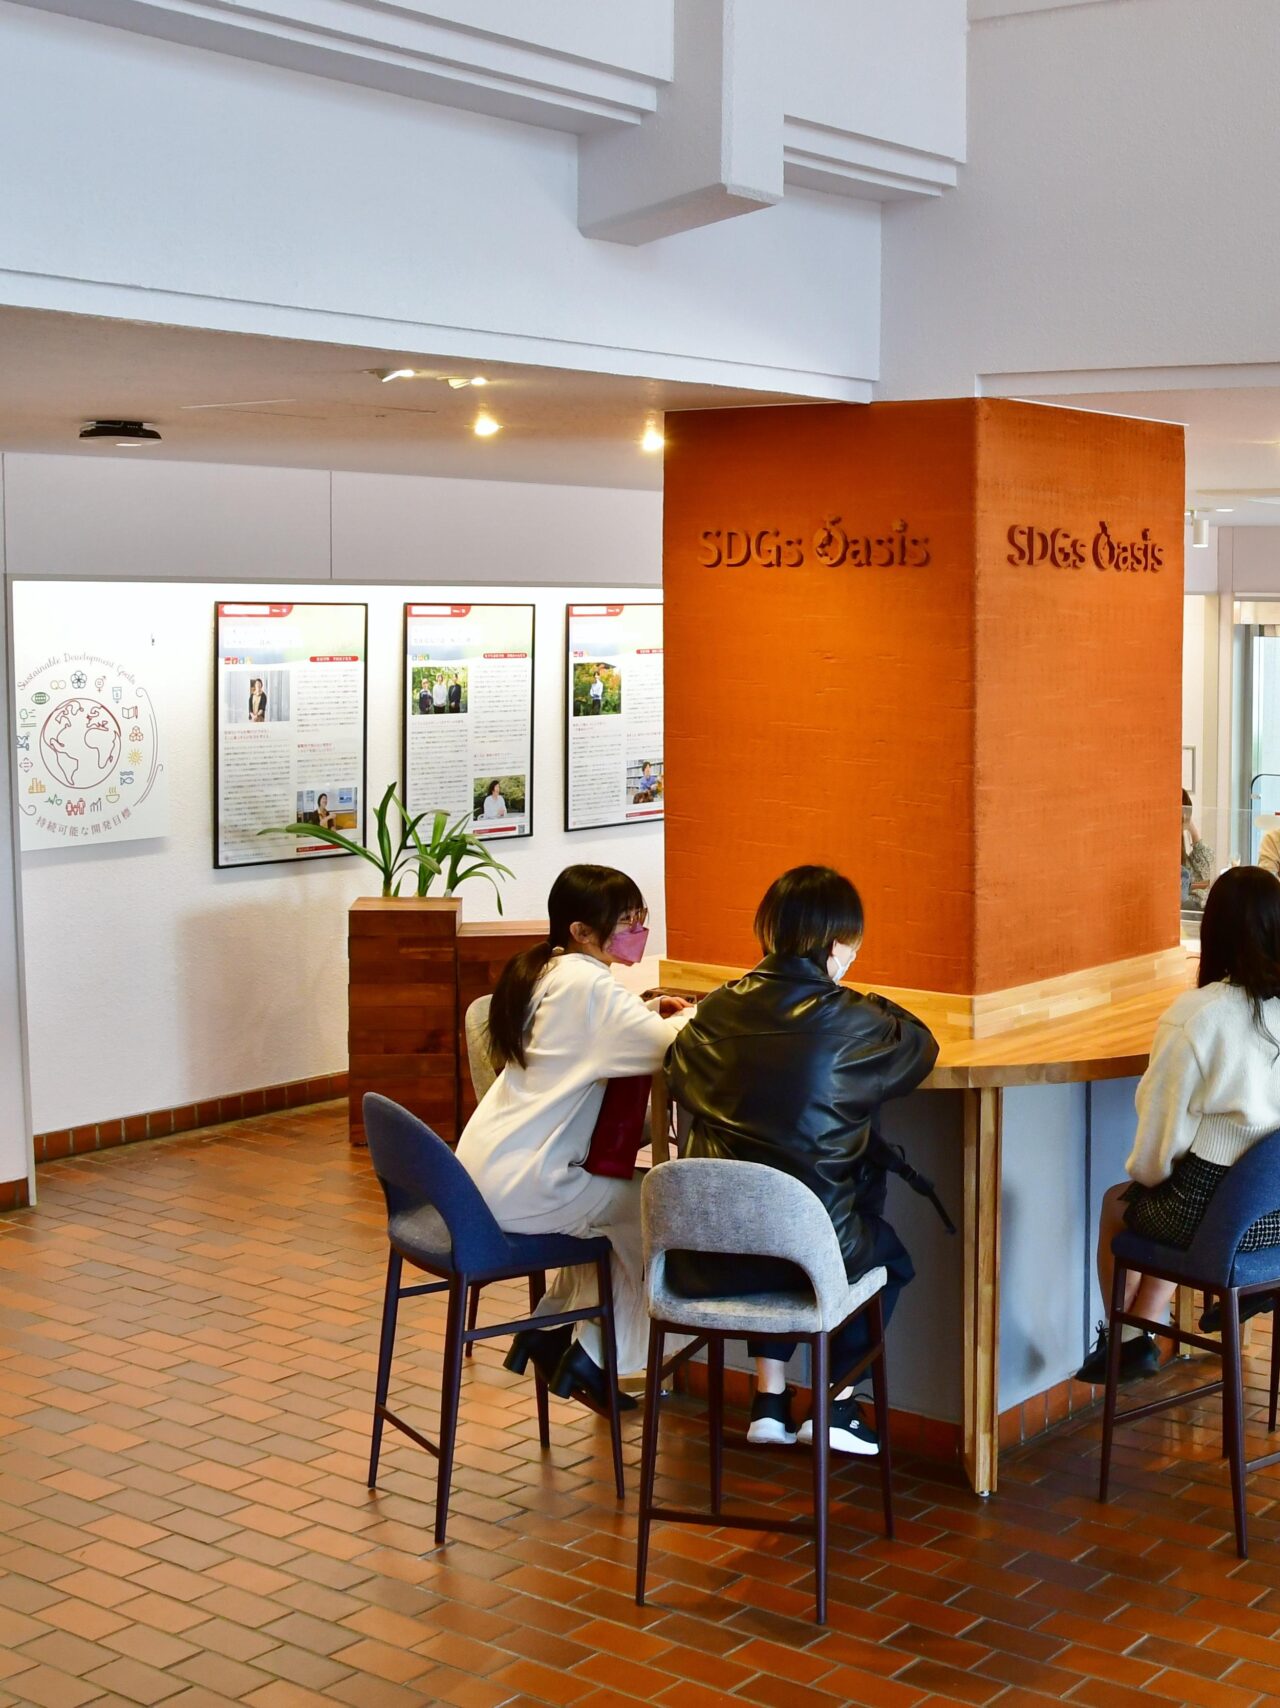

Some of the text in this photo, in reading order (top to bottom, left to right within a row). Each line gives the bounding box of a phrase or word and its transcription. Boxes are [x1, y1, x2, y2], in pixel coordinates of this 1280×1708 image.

[697, 514, 932, 568] SDGs Oasis
[1006, 520, 1165, 575] SDGs Oasis
[17, 652, 137, 692] Sustainable Development Goals
[34, 809, 132, 838] 持続可能な開発目標
